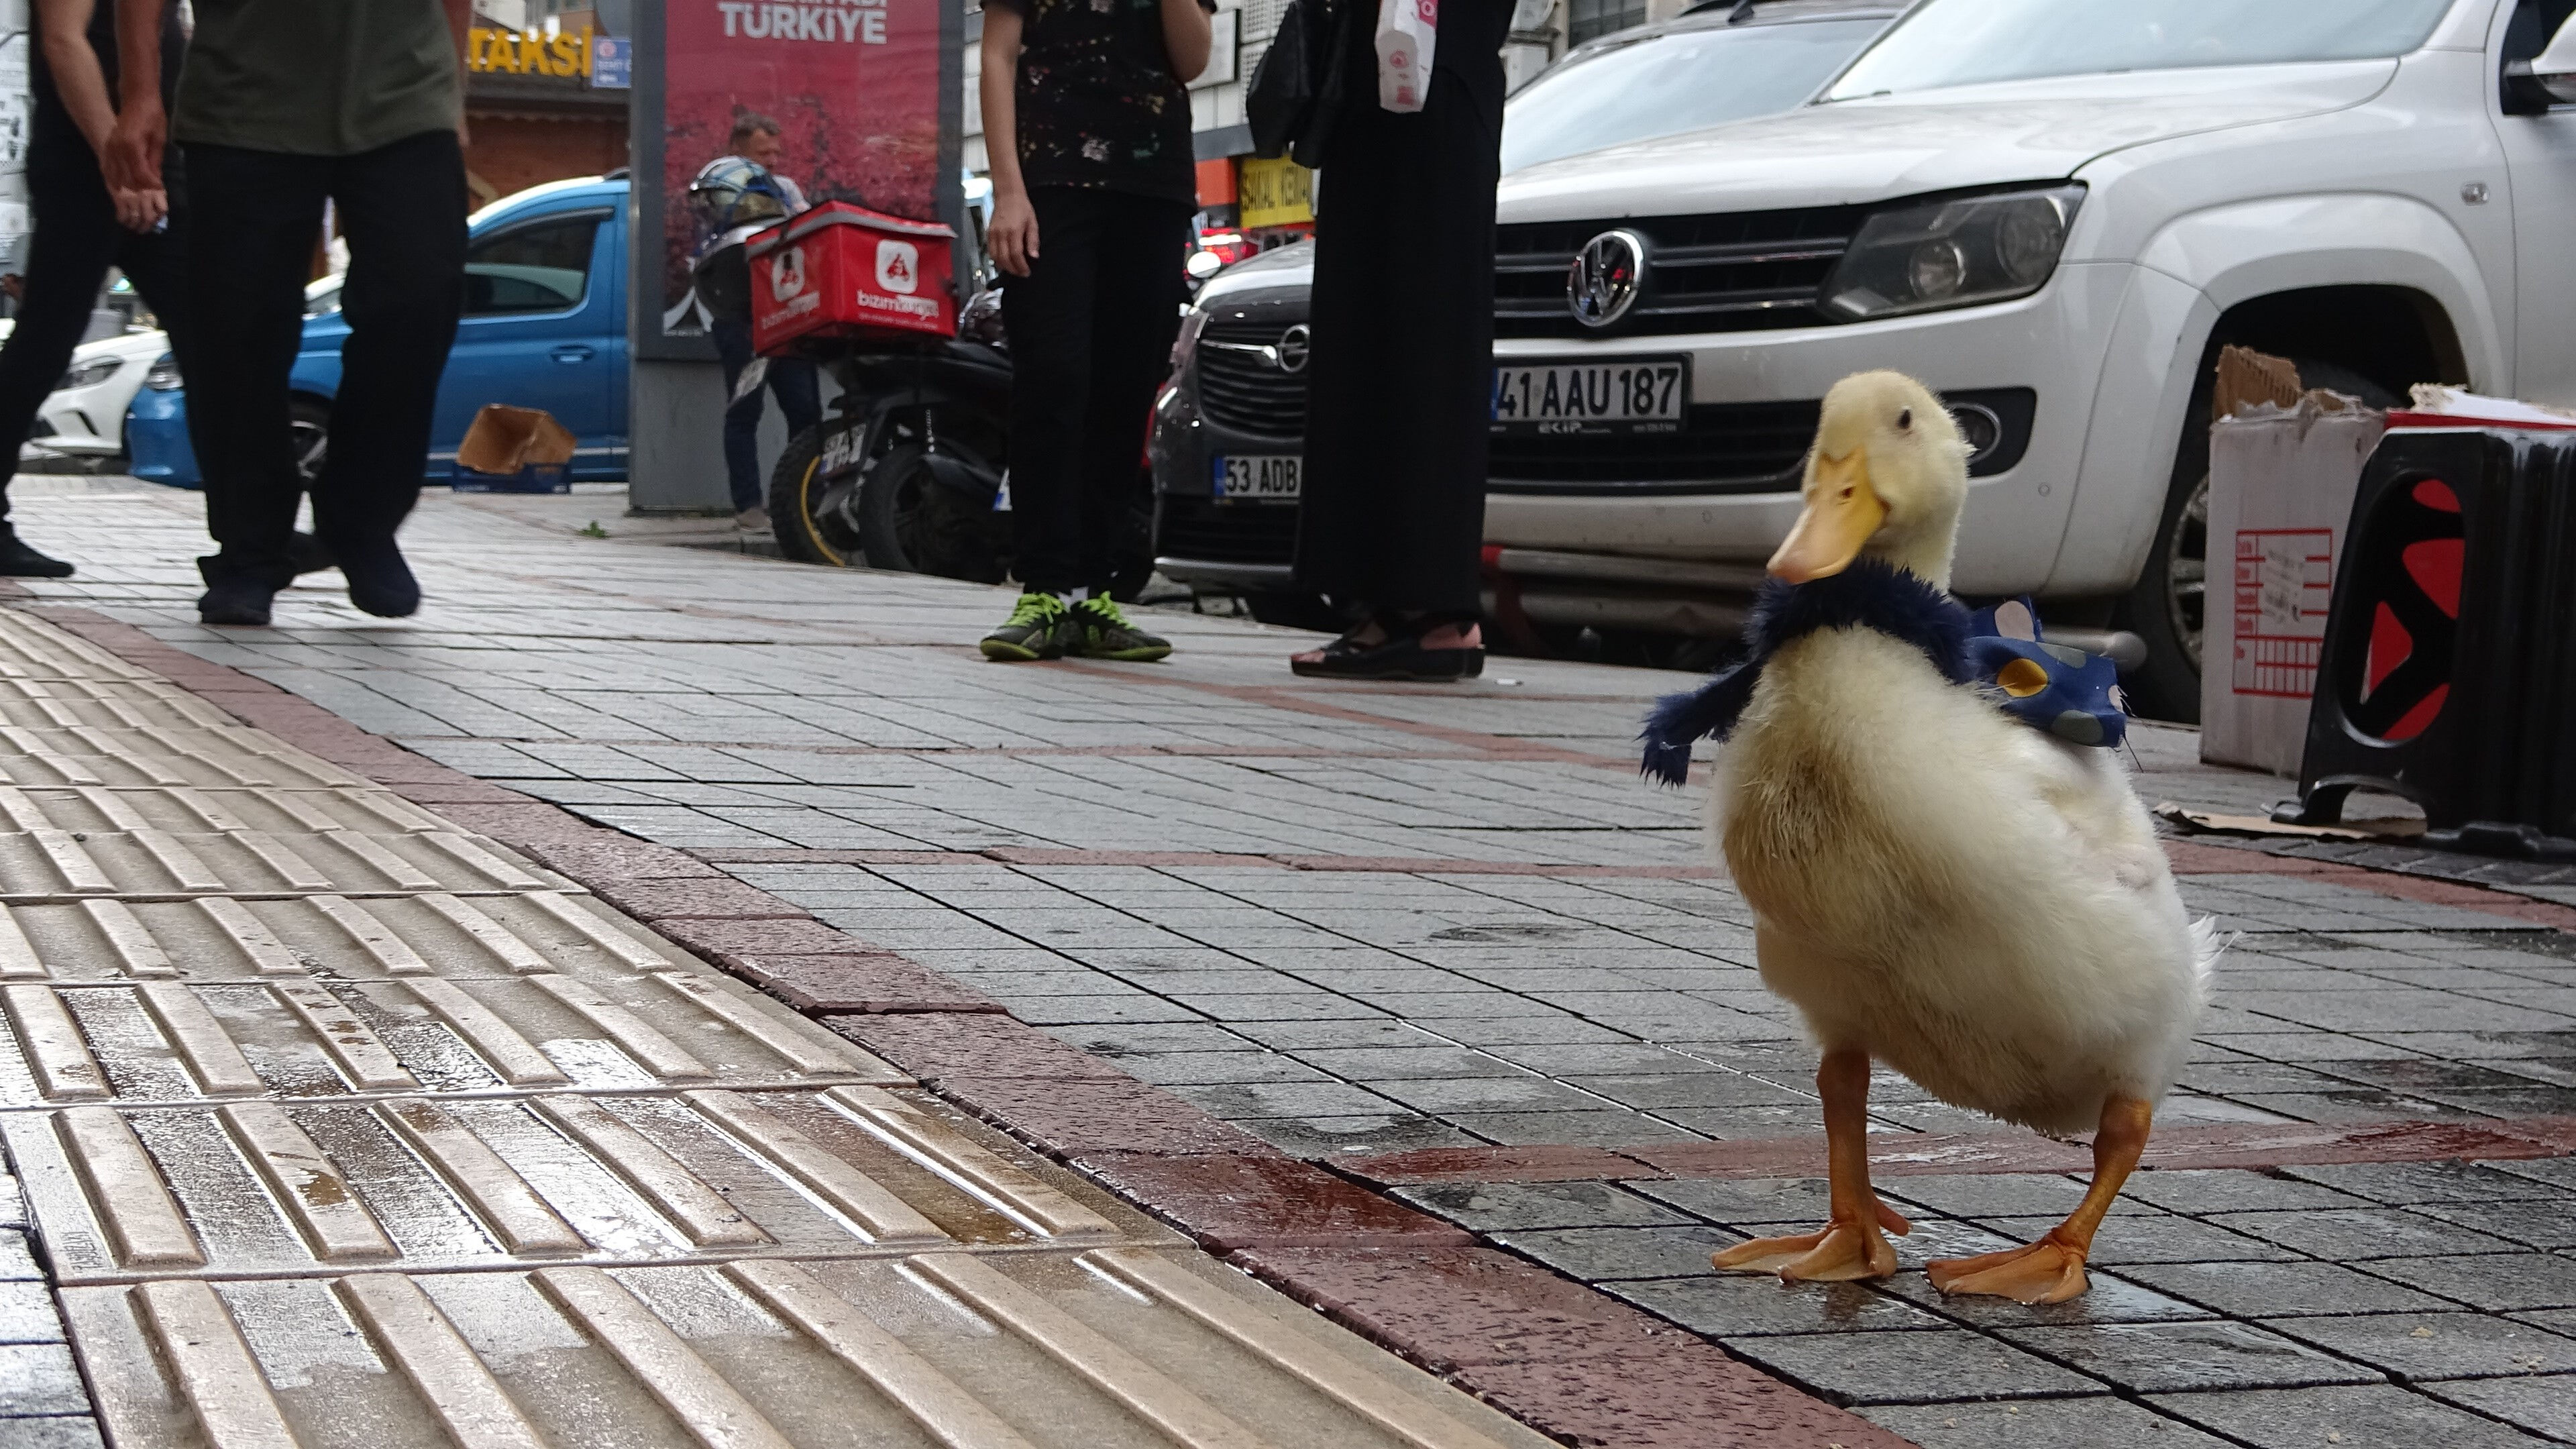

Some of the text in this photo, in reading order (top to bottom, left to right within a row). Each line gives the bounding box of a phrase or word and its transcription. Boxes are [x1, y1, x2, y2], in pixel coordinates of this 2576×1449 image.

[718, 3, 888, 44] TÜRKİYE
[469, 25, 592, 77] TAKSİ
[1496, 367, 1679, 417] 41 AAU 187
[1226, 459, 1297, 492] 53 ADB
